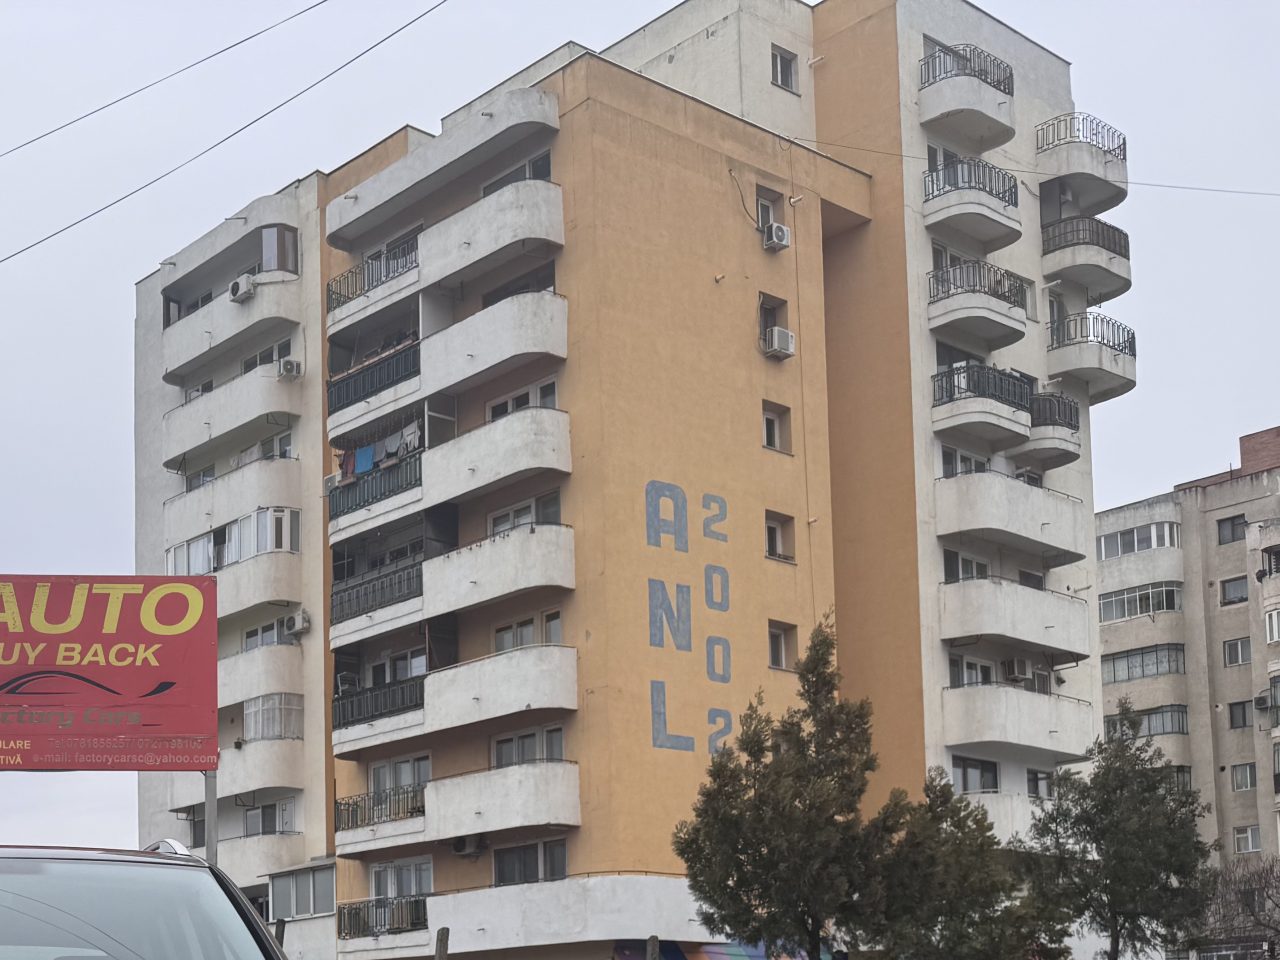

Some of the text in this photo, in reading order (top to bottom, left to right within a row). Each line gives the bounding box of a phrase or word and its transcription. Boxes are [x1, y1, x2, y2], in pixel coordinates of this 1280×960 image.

[55, 643, 162, 667] BACK
[82, 706, 142, 726] Cars
[74, 752, 218, 766] factorycarsc@yahoo.com
